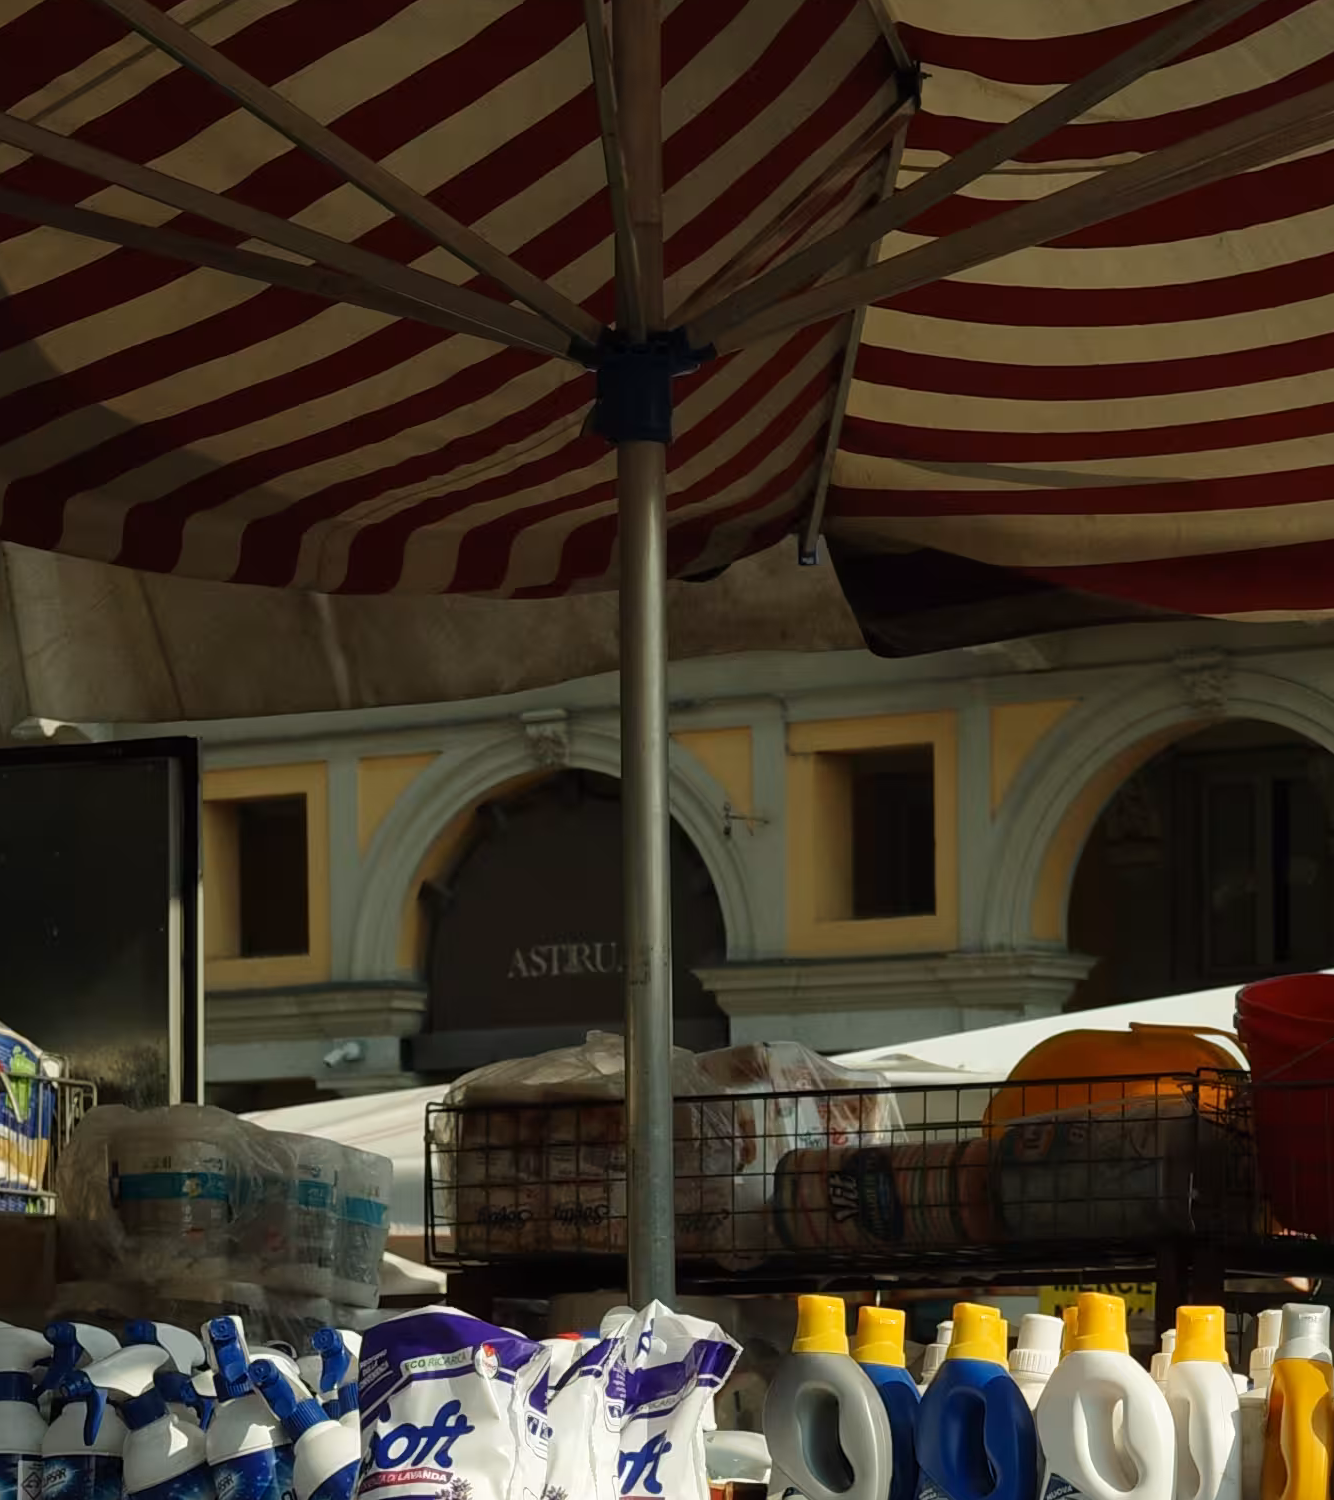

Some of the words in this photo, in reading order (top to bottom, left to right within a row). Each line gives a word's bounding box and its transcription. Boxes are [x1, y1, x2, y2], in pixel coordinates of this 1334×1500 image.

[405, 1359, 425, 1373] ECO
[426, 1350, 468, 1369] RICARICA
[397, 1469, 448, 1483] LAVANDA
